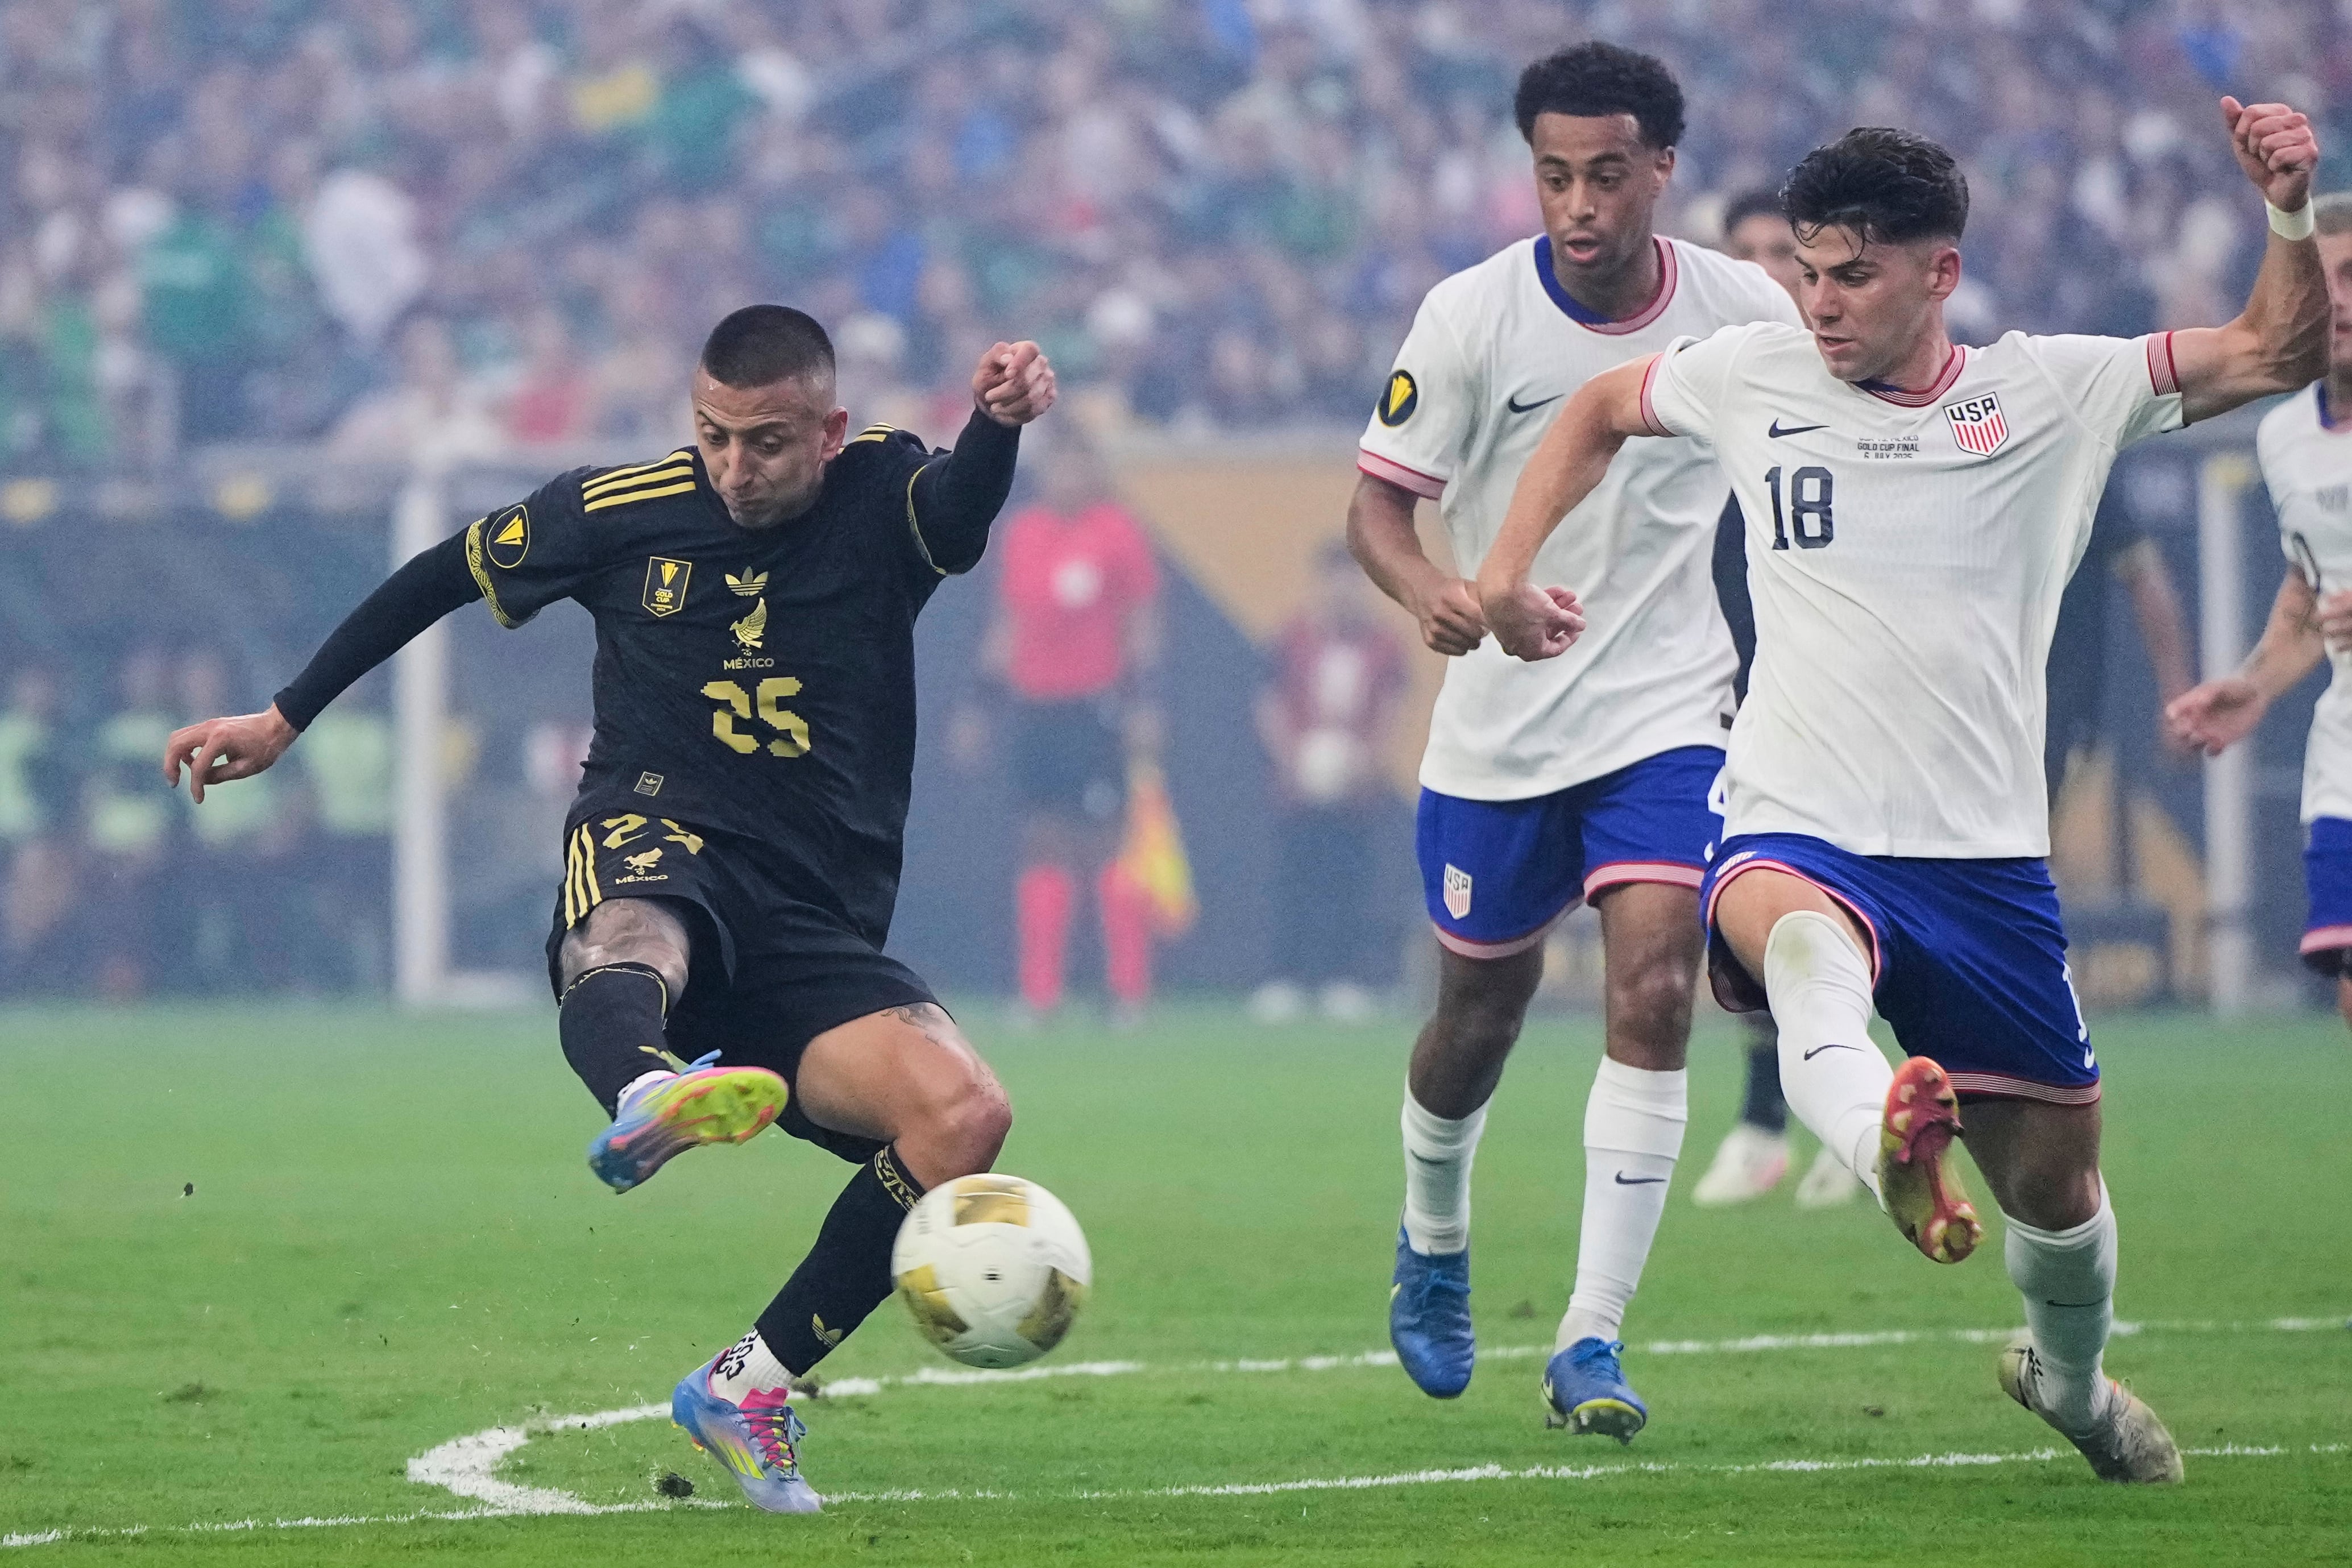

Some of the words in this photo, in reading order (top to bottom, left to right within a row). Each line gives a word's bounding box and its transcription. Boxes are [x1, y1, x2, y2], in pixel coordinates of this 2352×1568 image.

[1949, 397, 1996, 422] USA
[1765, 466, 1835, 550] 18
[723, 657, 774, 670] MÉXICO
[700, 677, 811, 758] 25
[615, 874, 669, 885] MÉXICO
[1446, 868, 1468, 890] USA
